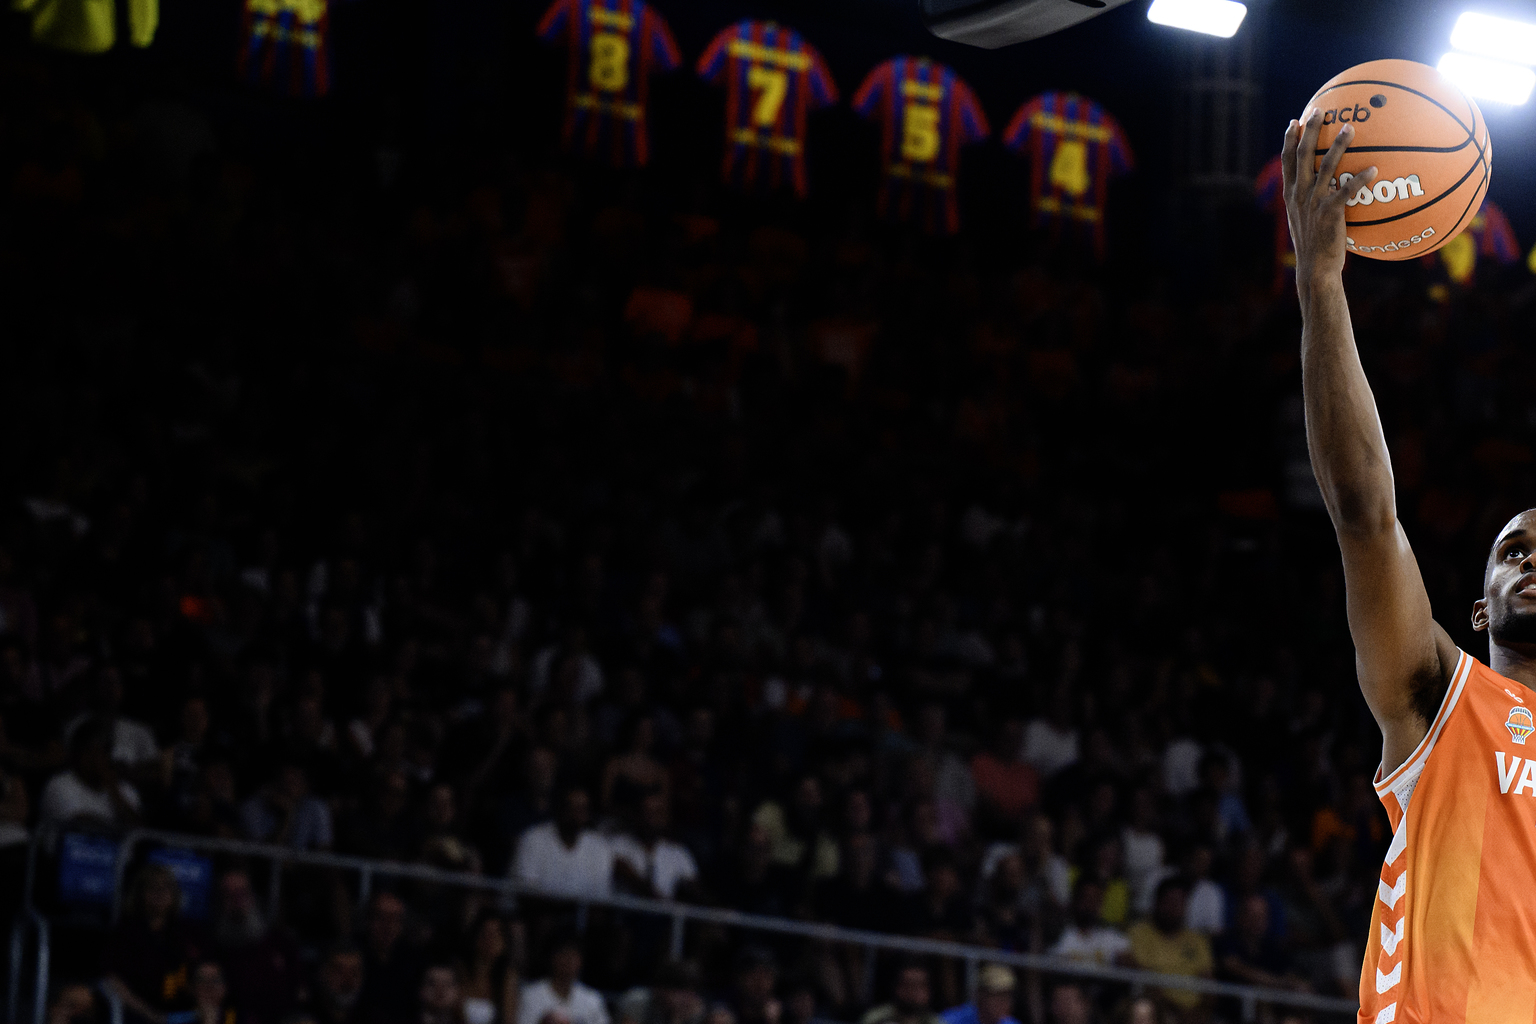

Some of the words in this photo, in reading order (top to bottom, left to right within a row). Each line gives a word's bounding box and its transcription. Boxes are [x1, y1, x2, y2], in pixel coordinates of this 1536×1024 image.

[587, 32, 630, 93] 8
[746, 65, 788, 126] 7
[1322, 104, 1371, 126] acb
[902, 104, 940, 162] 5
